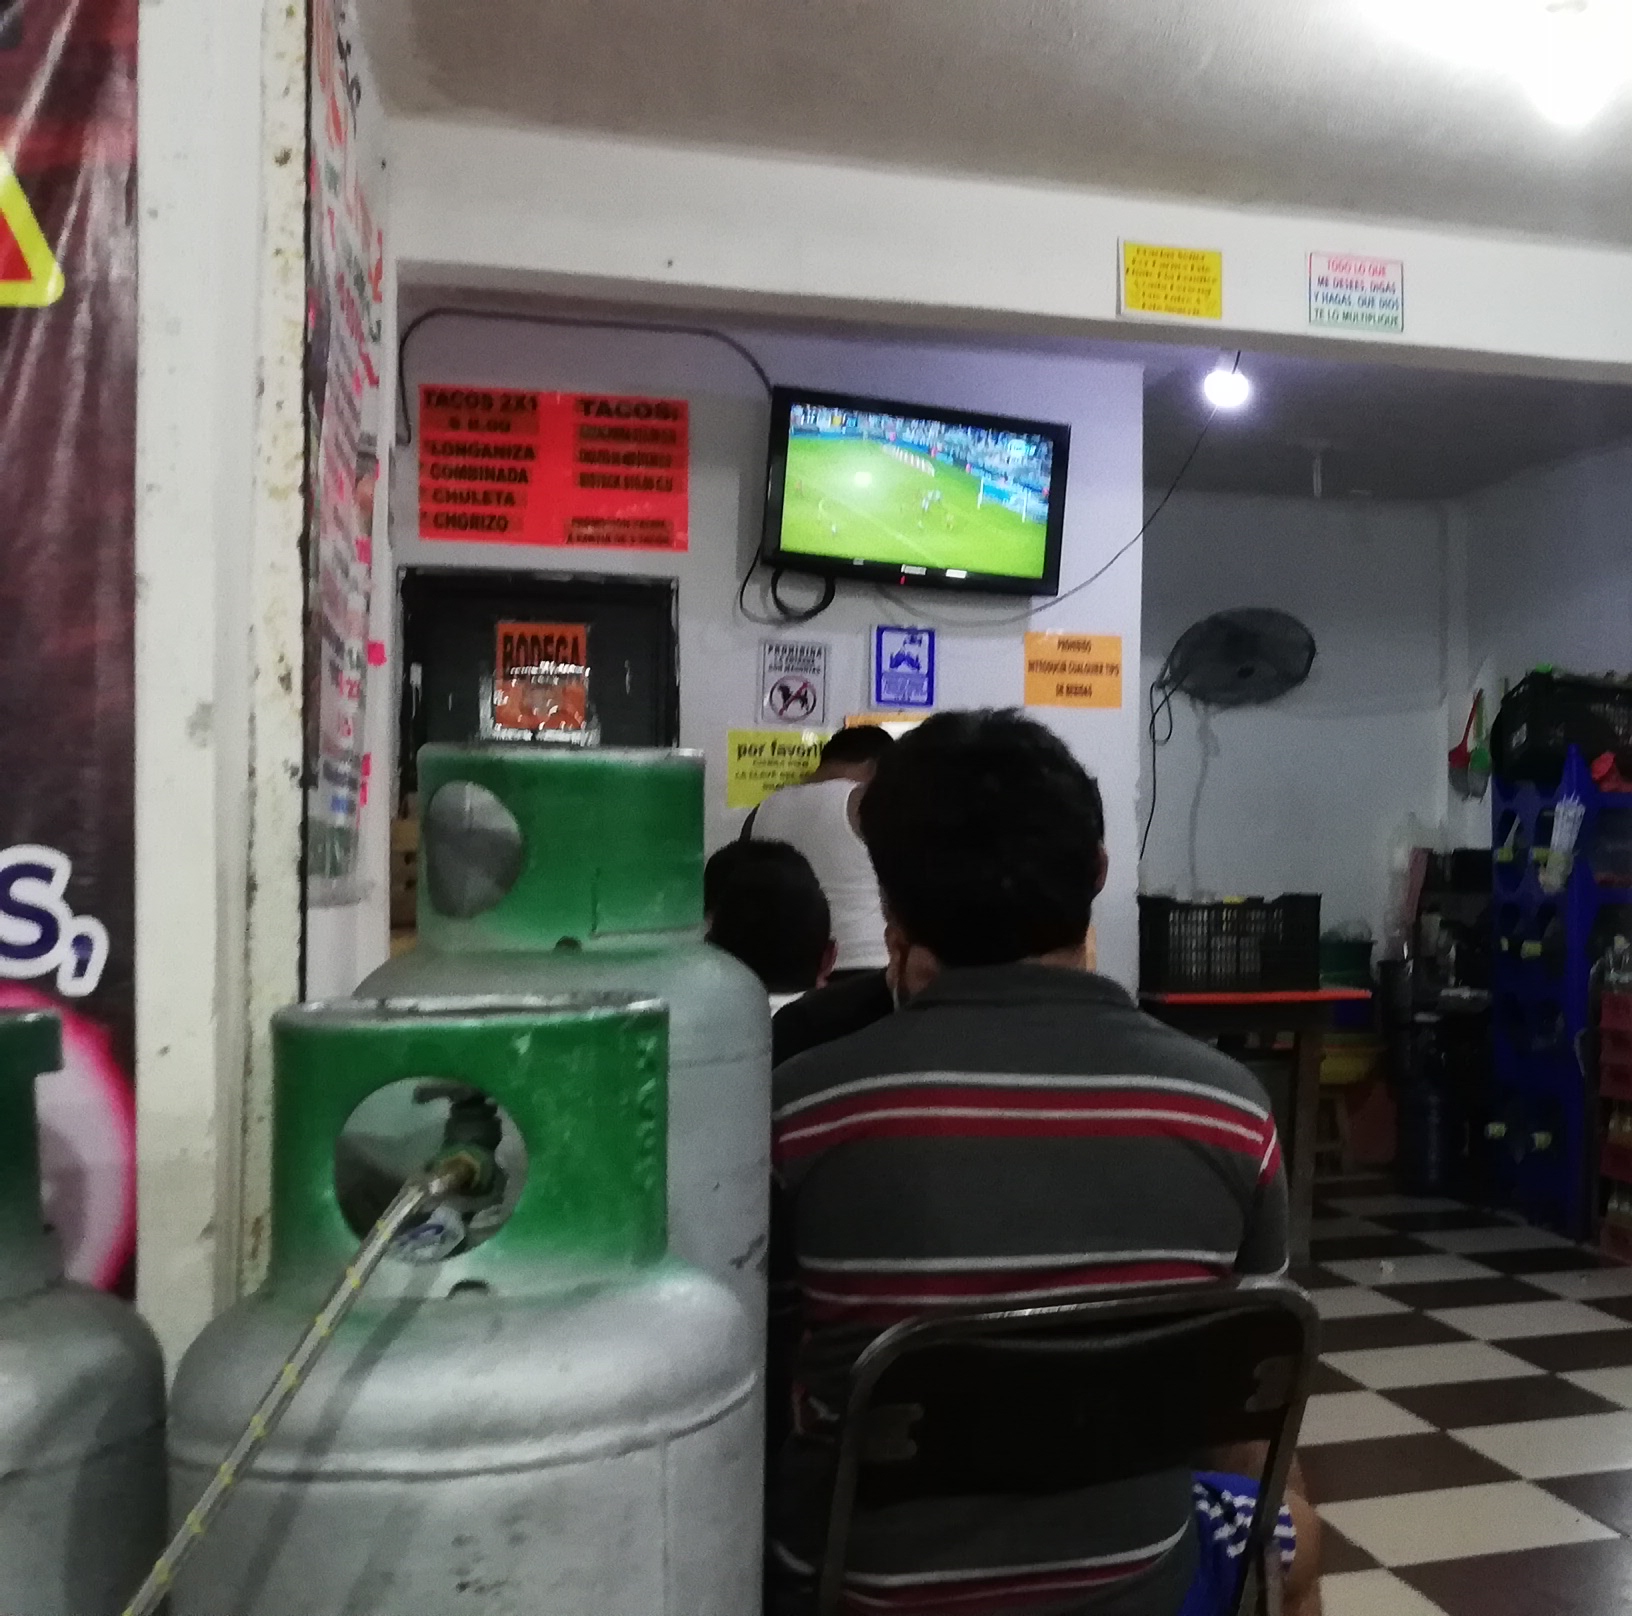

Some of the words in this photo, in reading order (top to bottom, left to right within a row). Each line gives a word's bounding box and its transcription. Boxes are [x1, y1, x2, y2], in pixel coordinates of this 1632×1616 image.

[424, 389, 493, 411] TACOS
[501, 393, 538, 412] 2X1
[431, 440, 536, 462] LONGANIZA
[430, 462, 529, 485] COMBINADA
[432, 487, 517, 507] CHULETA
[433, 511, 509, 534] CHORIZO
[737, 743, 767, 761] por
